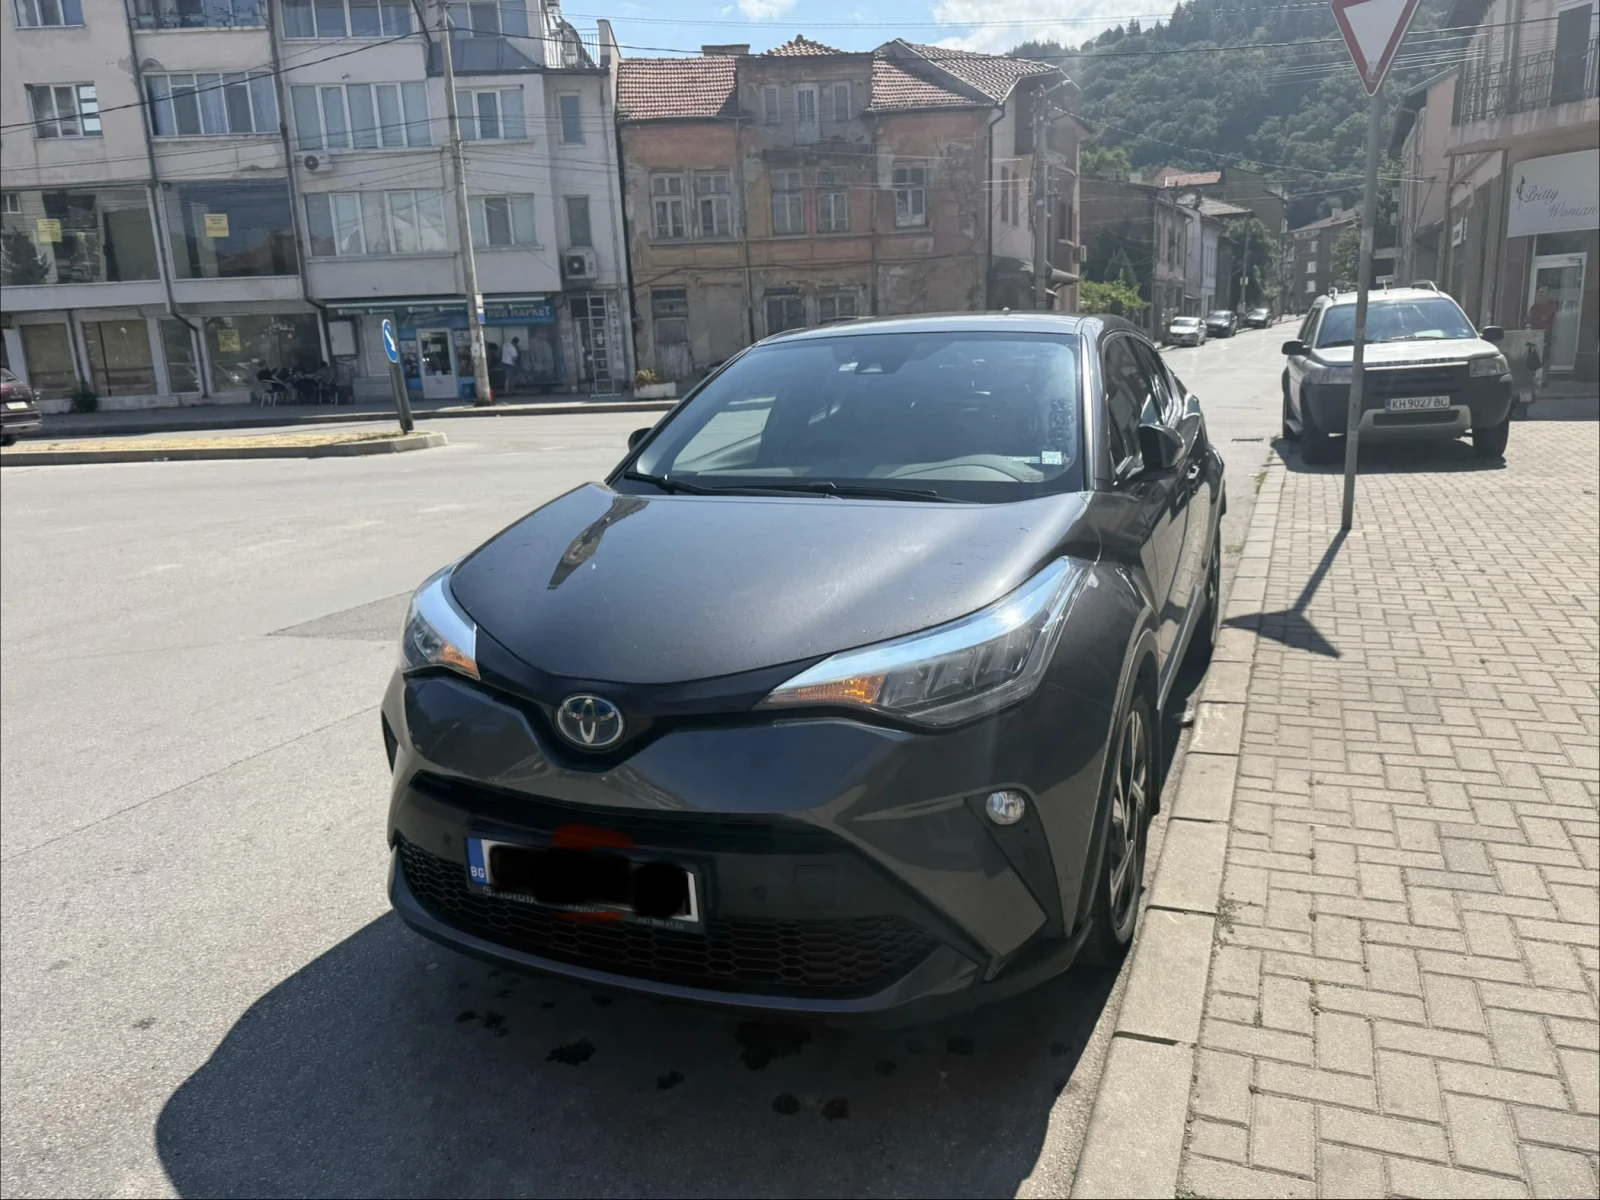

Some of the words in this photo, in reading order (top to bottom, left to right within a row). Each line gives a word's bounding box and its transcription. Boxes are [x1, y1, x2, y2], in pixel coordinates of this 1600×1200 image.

[1525, 185, 1559, 205] Pretty
[1548, 202, 1597, 219] Woman
[1392, 399, 1406, 409] KH
[1407, 397, 1432, 408] 9027
[470, 865, 485, 878] BG
